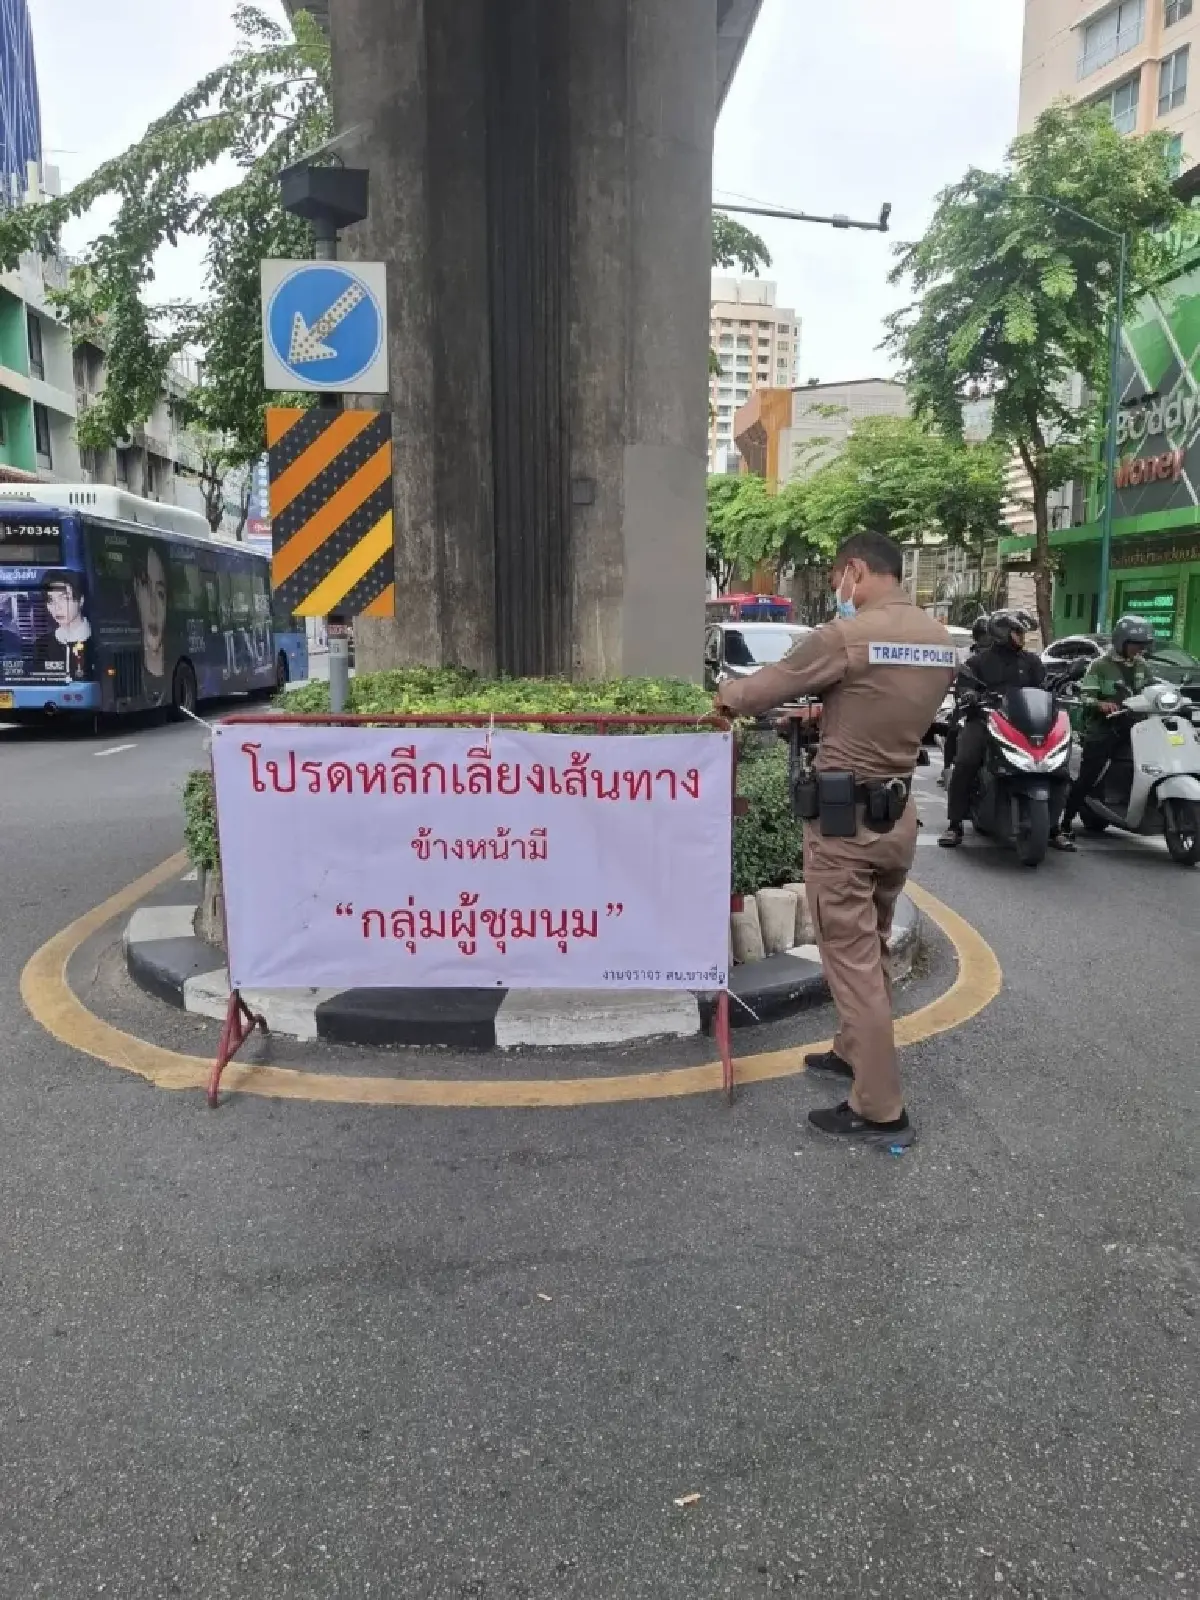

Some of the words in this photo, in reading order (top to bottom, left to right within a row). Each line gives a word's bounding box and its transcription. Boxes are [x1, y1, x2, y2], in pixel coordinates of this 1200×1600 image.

[5, 526, 60, 536] 1-70345
[872, 646, 920, 662] TRAFFIC
[922, 649, 954, 663] POLICE
[241, 734, 700, 801] โปรดหลีกเลี่ยงเส้นทาง
[410, 826, 548, 861] ข้างหน้ามี
